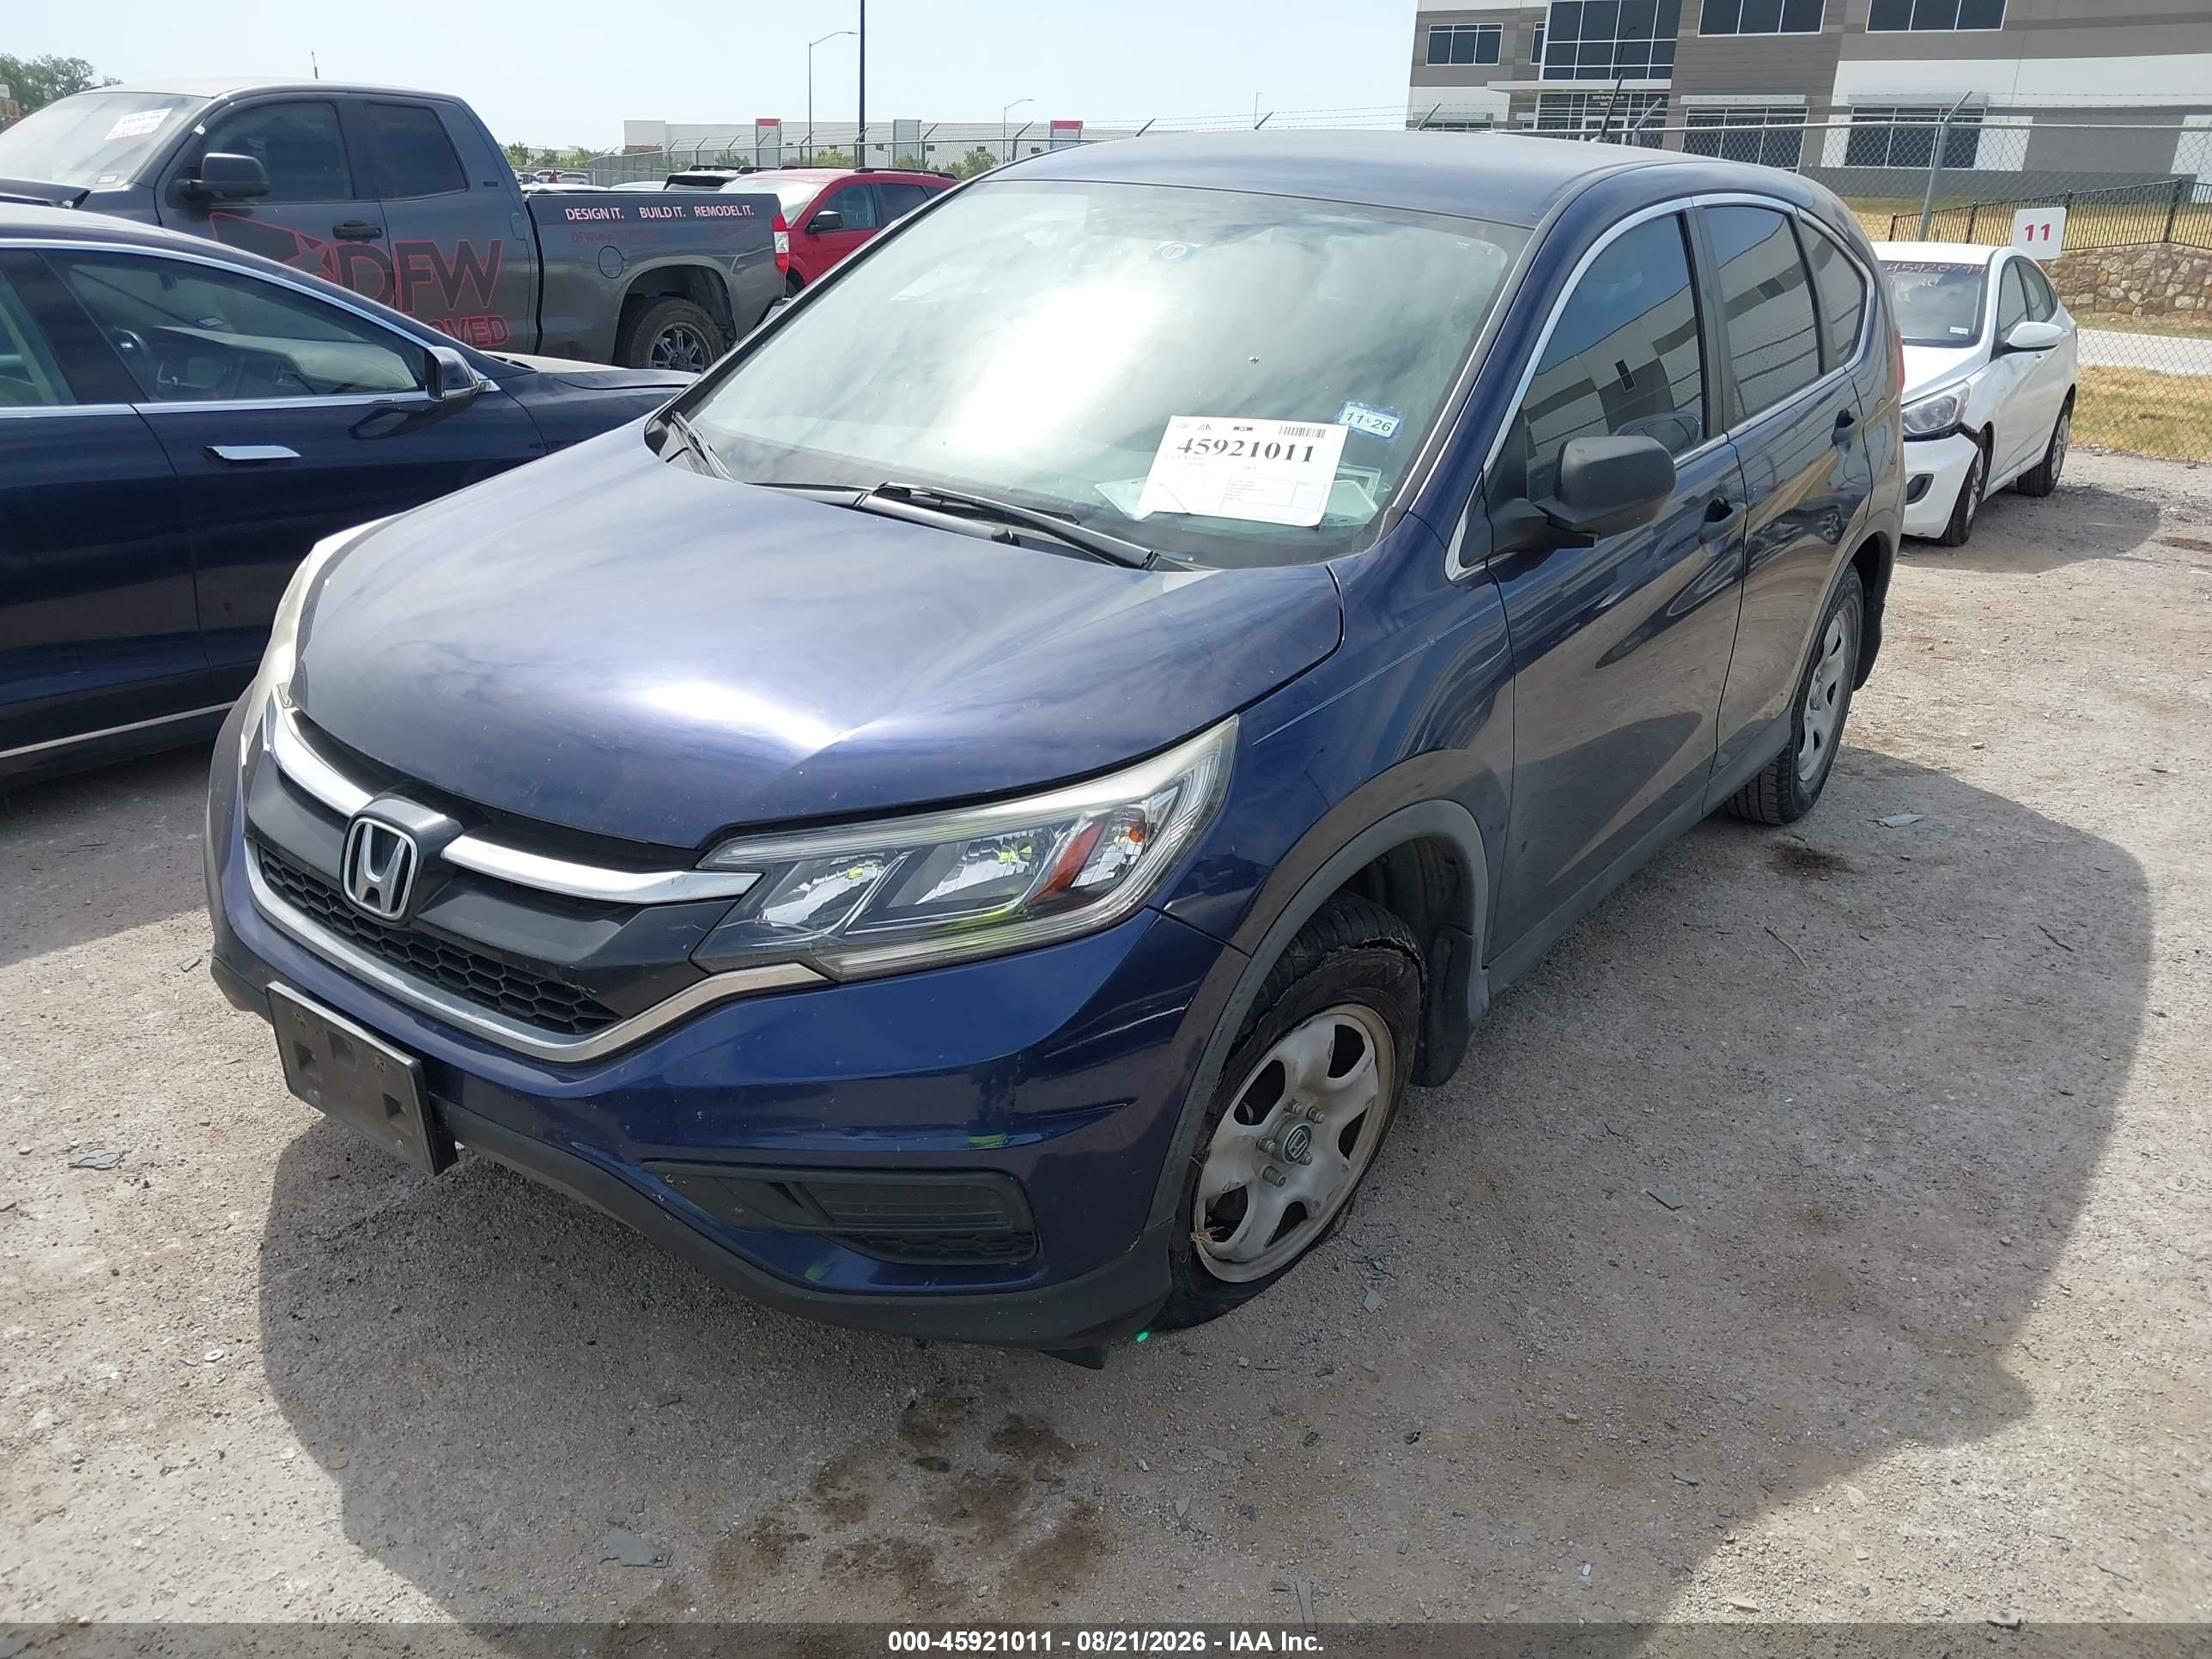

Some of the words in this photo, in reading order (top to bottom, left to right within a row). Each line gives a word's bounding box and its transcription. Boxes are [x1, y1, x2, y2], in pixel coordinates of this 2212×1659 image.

[565, 208, 610, 221] DESIGN
[611, 207, 624, 220] IT.
[639, 207, 672, 219] BUILD
[673, 206, 686, 218] IT.
[694, 205, 743, 217] REMODEL
[743, 204, 755, 216] IT.
[2025, 223, 2051, 241] 11
[335, 238, 503, 314] DFW
[1346, 412, 1364, 423] 11
[1370, 418, 1393, 432] 26
[1177, 438, 1314, 463] 45921011
